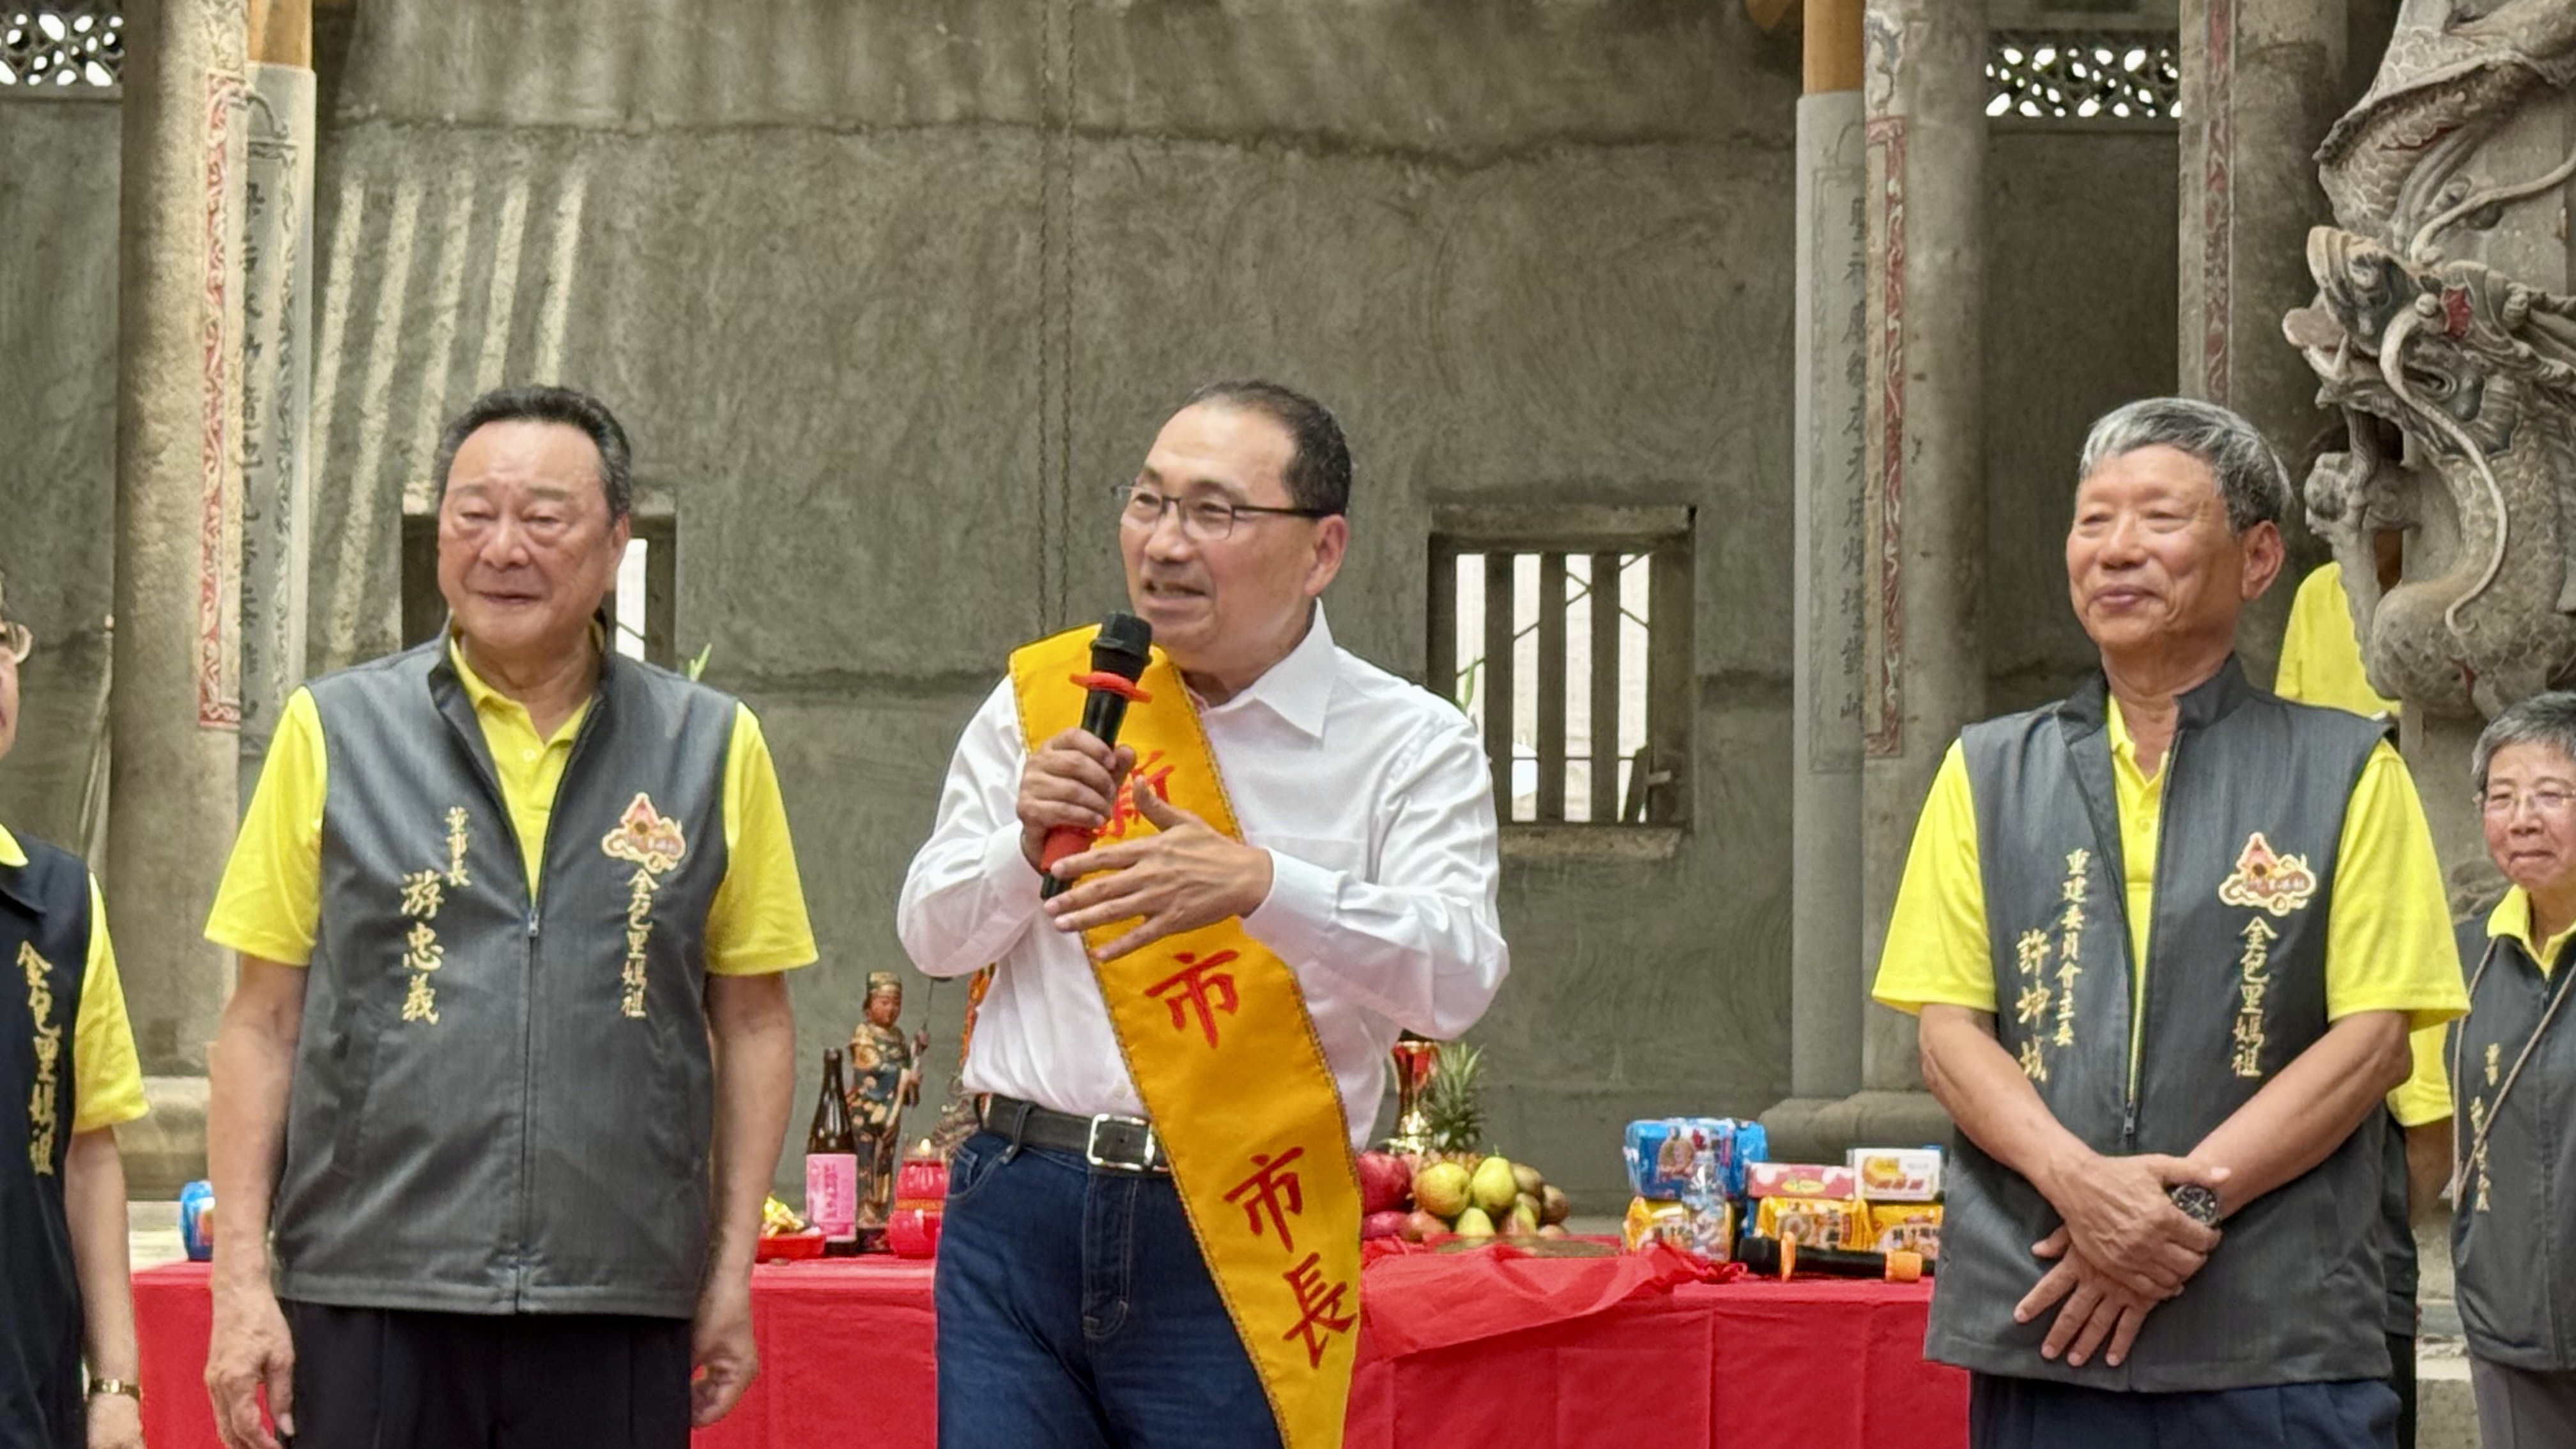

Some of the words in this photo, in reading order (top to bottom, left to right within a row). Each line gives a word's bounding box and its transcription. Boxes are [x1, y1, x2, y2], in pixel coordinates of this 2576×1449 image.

[401, 870, 445, 1025] 游忠義
[2231, 916, 2278, 1077] 金包里媽祖
[1223, 1146, 1358, 1368] 市長
